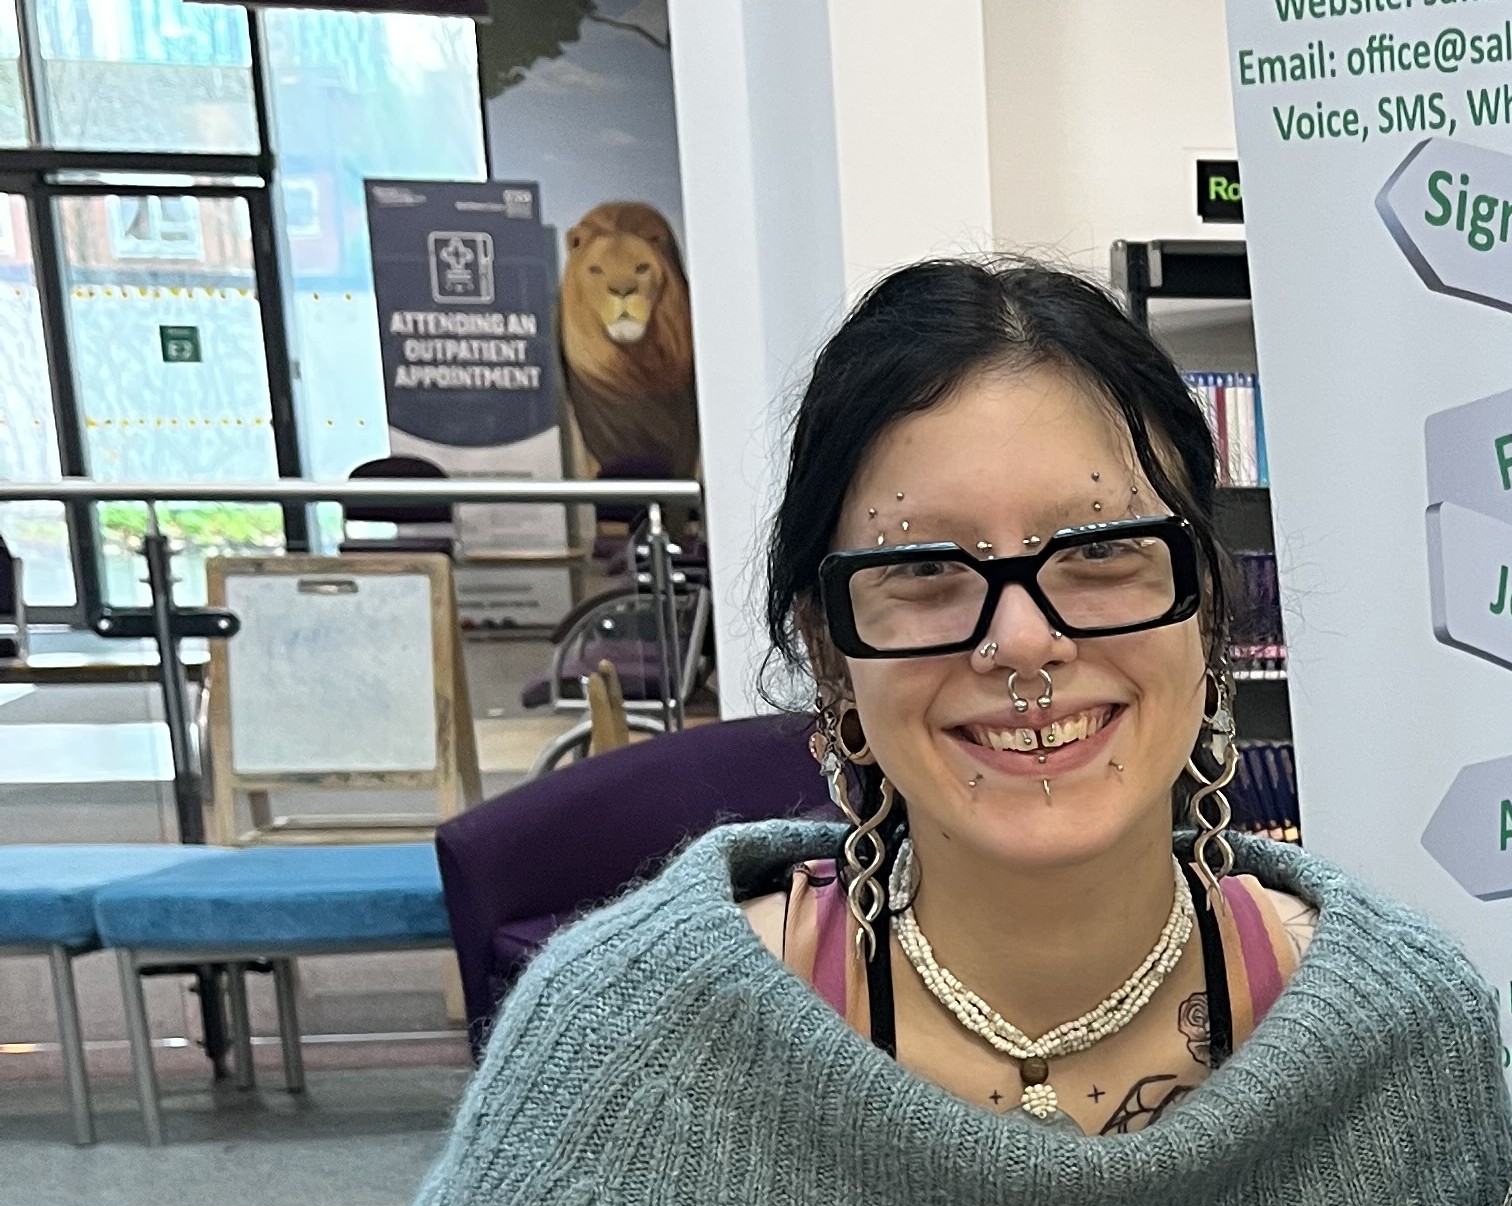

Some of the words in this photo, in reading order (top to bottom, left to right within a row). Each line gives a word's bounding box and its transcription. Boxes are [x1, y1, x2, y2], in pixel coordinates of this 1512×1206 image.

[1238, 41, 1337, 85] Email:
[1273, 101, 1369, 143] Voice,
[1379, 92, 1457, 135] SMS,
[1209, 176, 1243, 201] Ro
[390, 312, 505, 336] ATTENDING
[507, 313, 537, 337] AN
[403, 339, 527, 363] OUTPATIENT
[395, 365, 541, 389] APPOINTMENT
